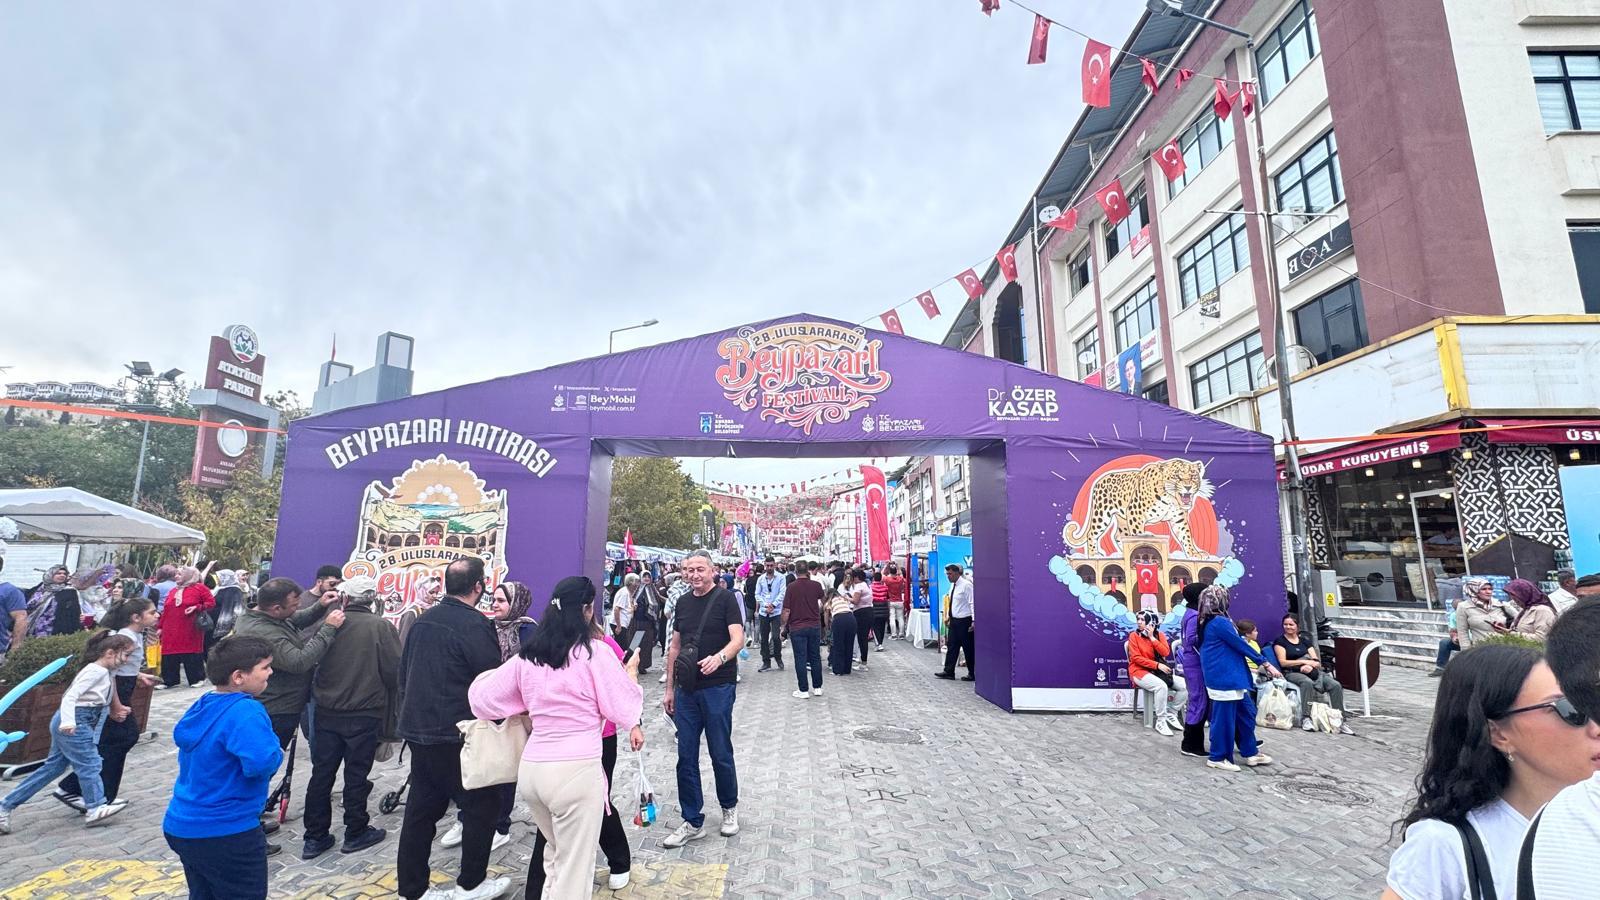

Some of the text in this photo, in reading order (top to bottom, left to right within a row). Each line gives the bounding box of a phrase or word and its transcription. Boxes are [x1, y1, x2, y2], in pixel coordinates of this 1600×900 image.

[763, 384, 847, 408] FESTİVALİ
[988, 385, 1057, 402] Dr. ÖZER
[988, 401, 1059, 417] KASAP
[325, 418, 558, 478] BEYPAZARI HATIRASI
[1341, 441, 1429, 468] KURUYEMİŞ
